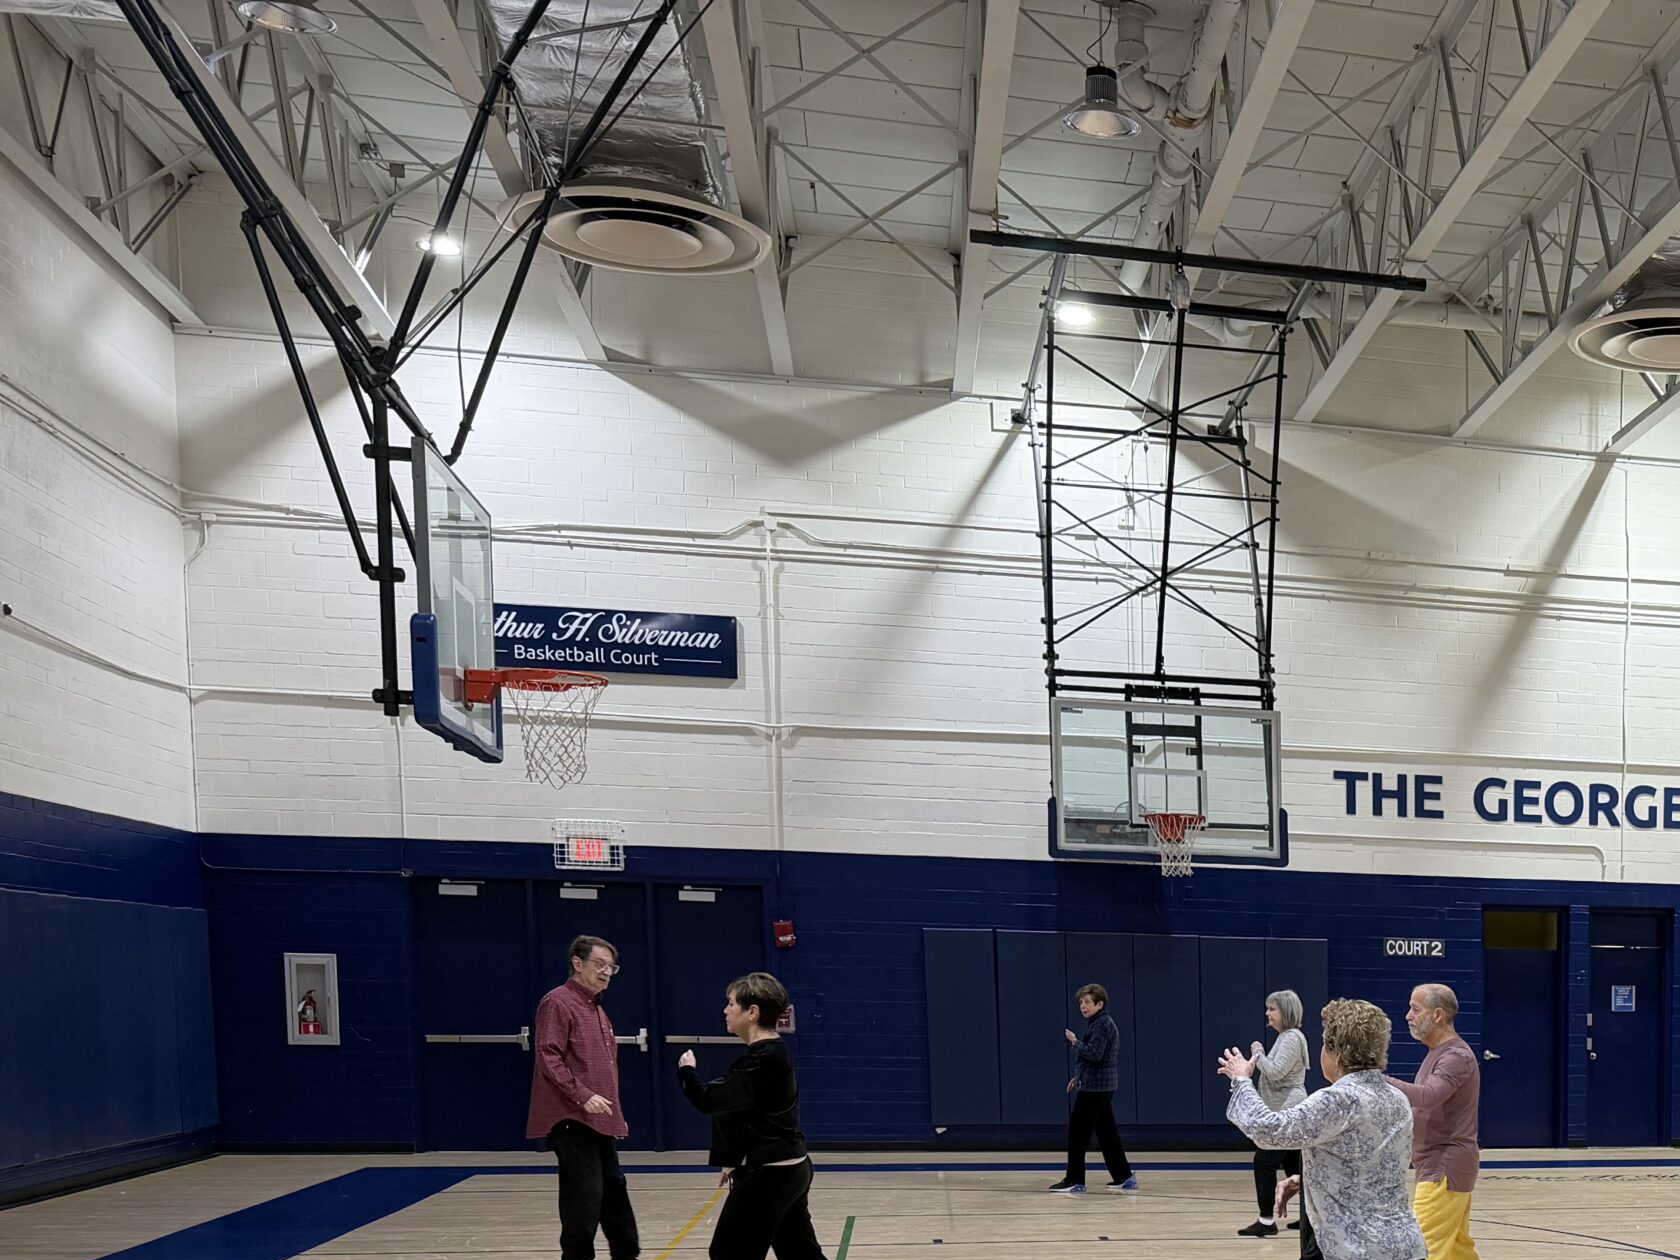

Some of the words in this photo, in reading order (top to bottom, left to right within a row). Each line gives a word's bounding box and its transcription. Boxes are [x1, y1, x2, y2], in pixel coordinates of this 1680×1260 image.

[493, 610, 546, 640] thur
[552, 610, 605, 642] H.
[598, 612, 722, 649] Silverman
[513, 644, 606, 664] Basketball
[610, 649, 660, 667] Court
[1332, 769, 1445, 820] THE
[575, 838, 603, 860] EXIT
[1386, 939, 1430, 956] COURT
[1431, 941, 1443, 956] 2
